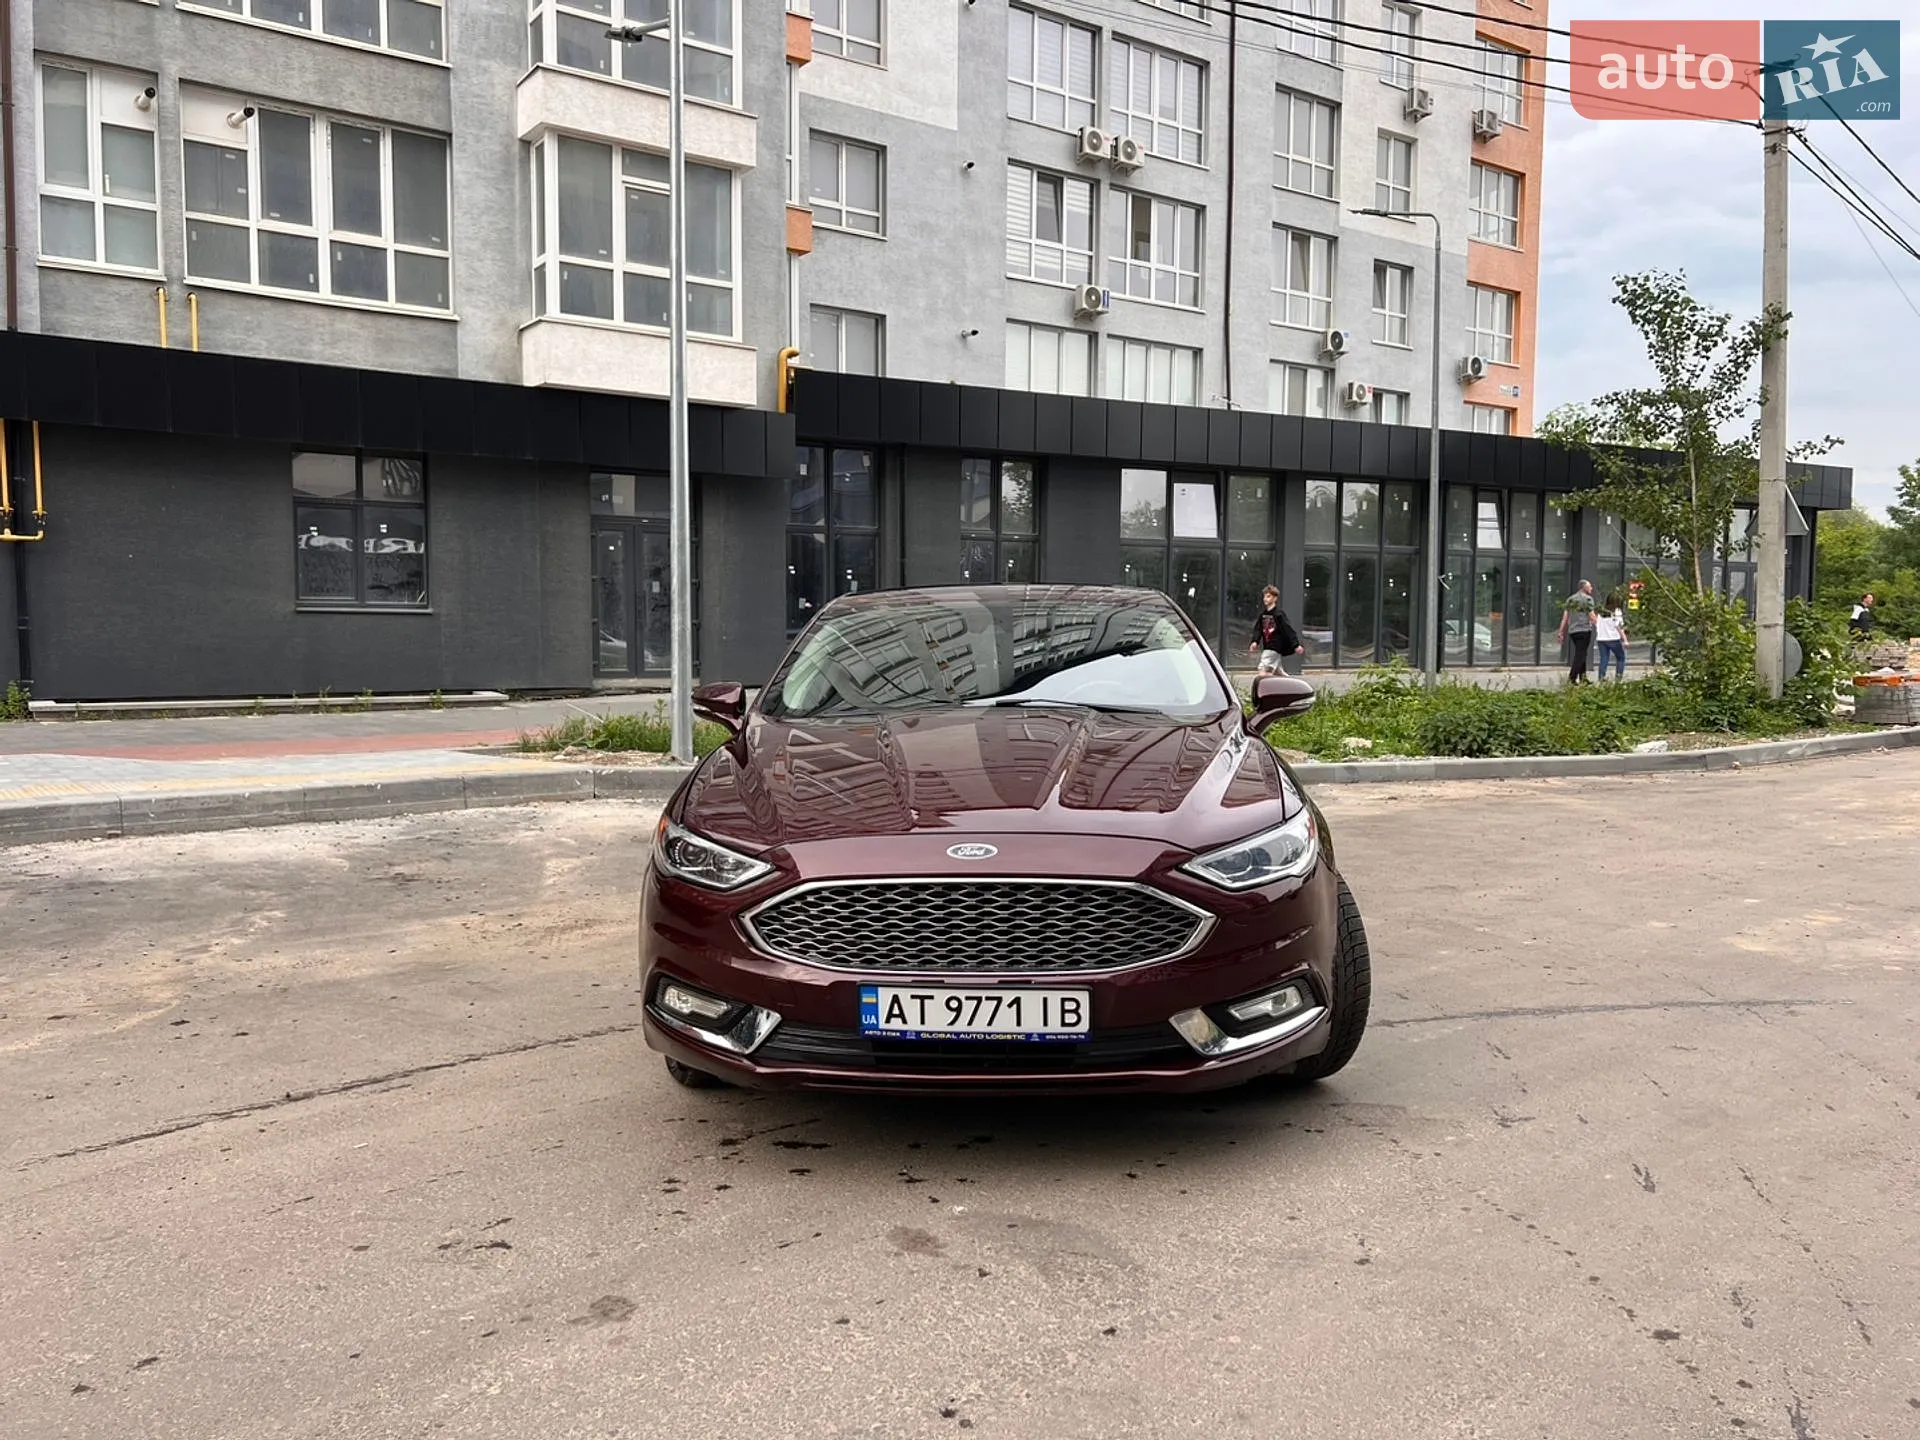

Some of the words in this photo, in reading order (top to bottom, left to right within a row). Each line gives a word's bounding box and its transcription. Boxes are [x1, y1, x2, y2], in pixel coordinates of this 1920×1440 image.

[862, 1014, 877, 1025] UA
[884, 994, 935, 1025] AT
[944, 995, 1022, 1027] 9771
[1042, 996, 1082, 1028] IB
